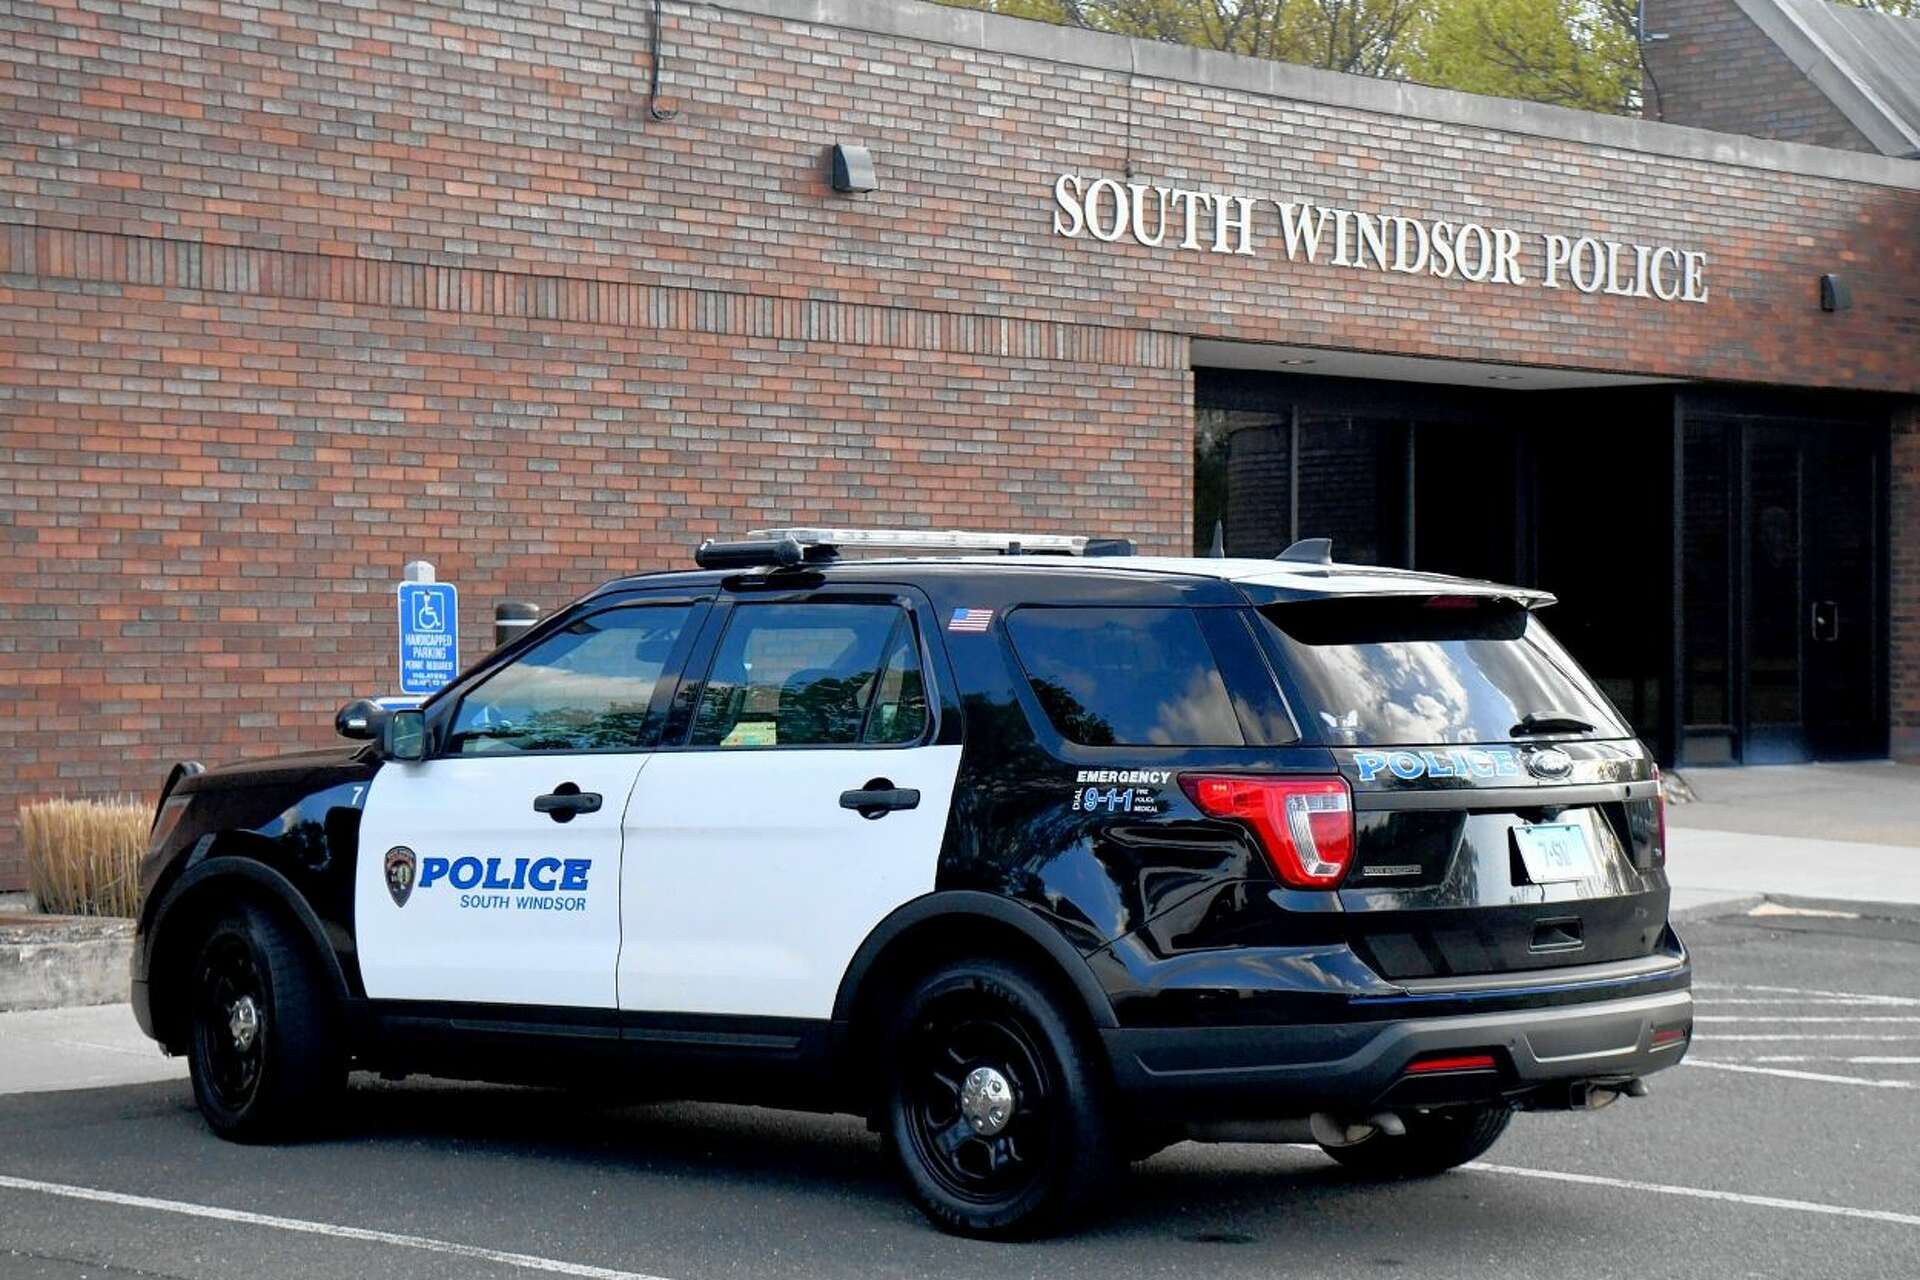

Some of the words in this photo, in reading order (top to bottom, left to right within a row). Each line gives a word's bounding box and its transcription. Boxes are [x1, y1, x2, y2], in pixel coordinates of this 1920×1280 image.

[1053, 173, 1256, 256] SOUTH
[1275, 201, 1526, 286] WINDSOR
[1542, 233, 1709, 302] POLICE
[405, 634, 452, 647] HANDICAPPED
[413, 647, 446, 659] PARKING
[1353, 750, 1519, 782] POLICE
[1076, 770, 1171, 784] EMERGENCY
[352, 786, 363, 805] 7
[1072, 787, 1083, 810] DIAL
[1083, 787, 1133, 811] 9-1-1
[418, 856, 592, 891] POLICE
[460, 894, 509, 909] SOUTH
[516, 896, 587, 911] WINDSOR
